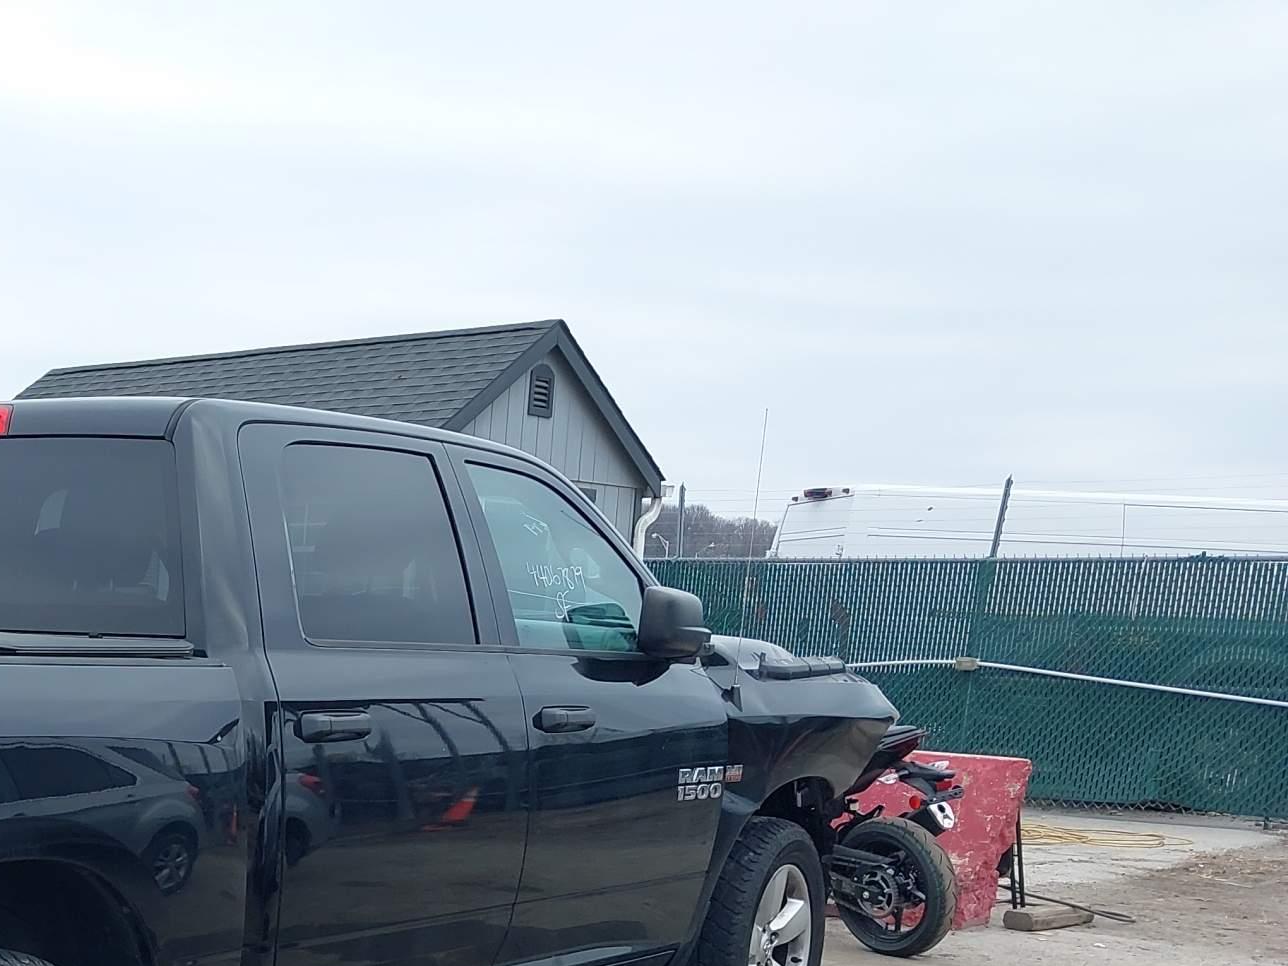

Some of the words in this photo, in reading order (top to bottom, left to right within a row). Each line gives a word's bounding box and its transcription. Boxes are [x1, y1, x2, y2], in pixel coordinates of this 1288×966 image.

[526, 562, 586, 592] 44067879
[678, 766, 724, 784] RAM
[677, 782, 722, 801] 1500
